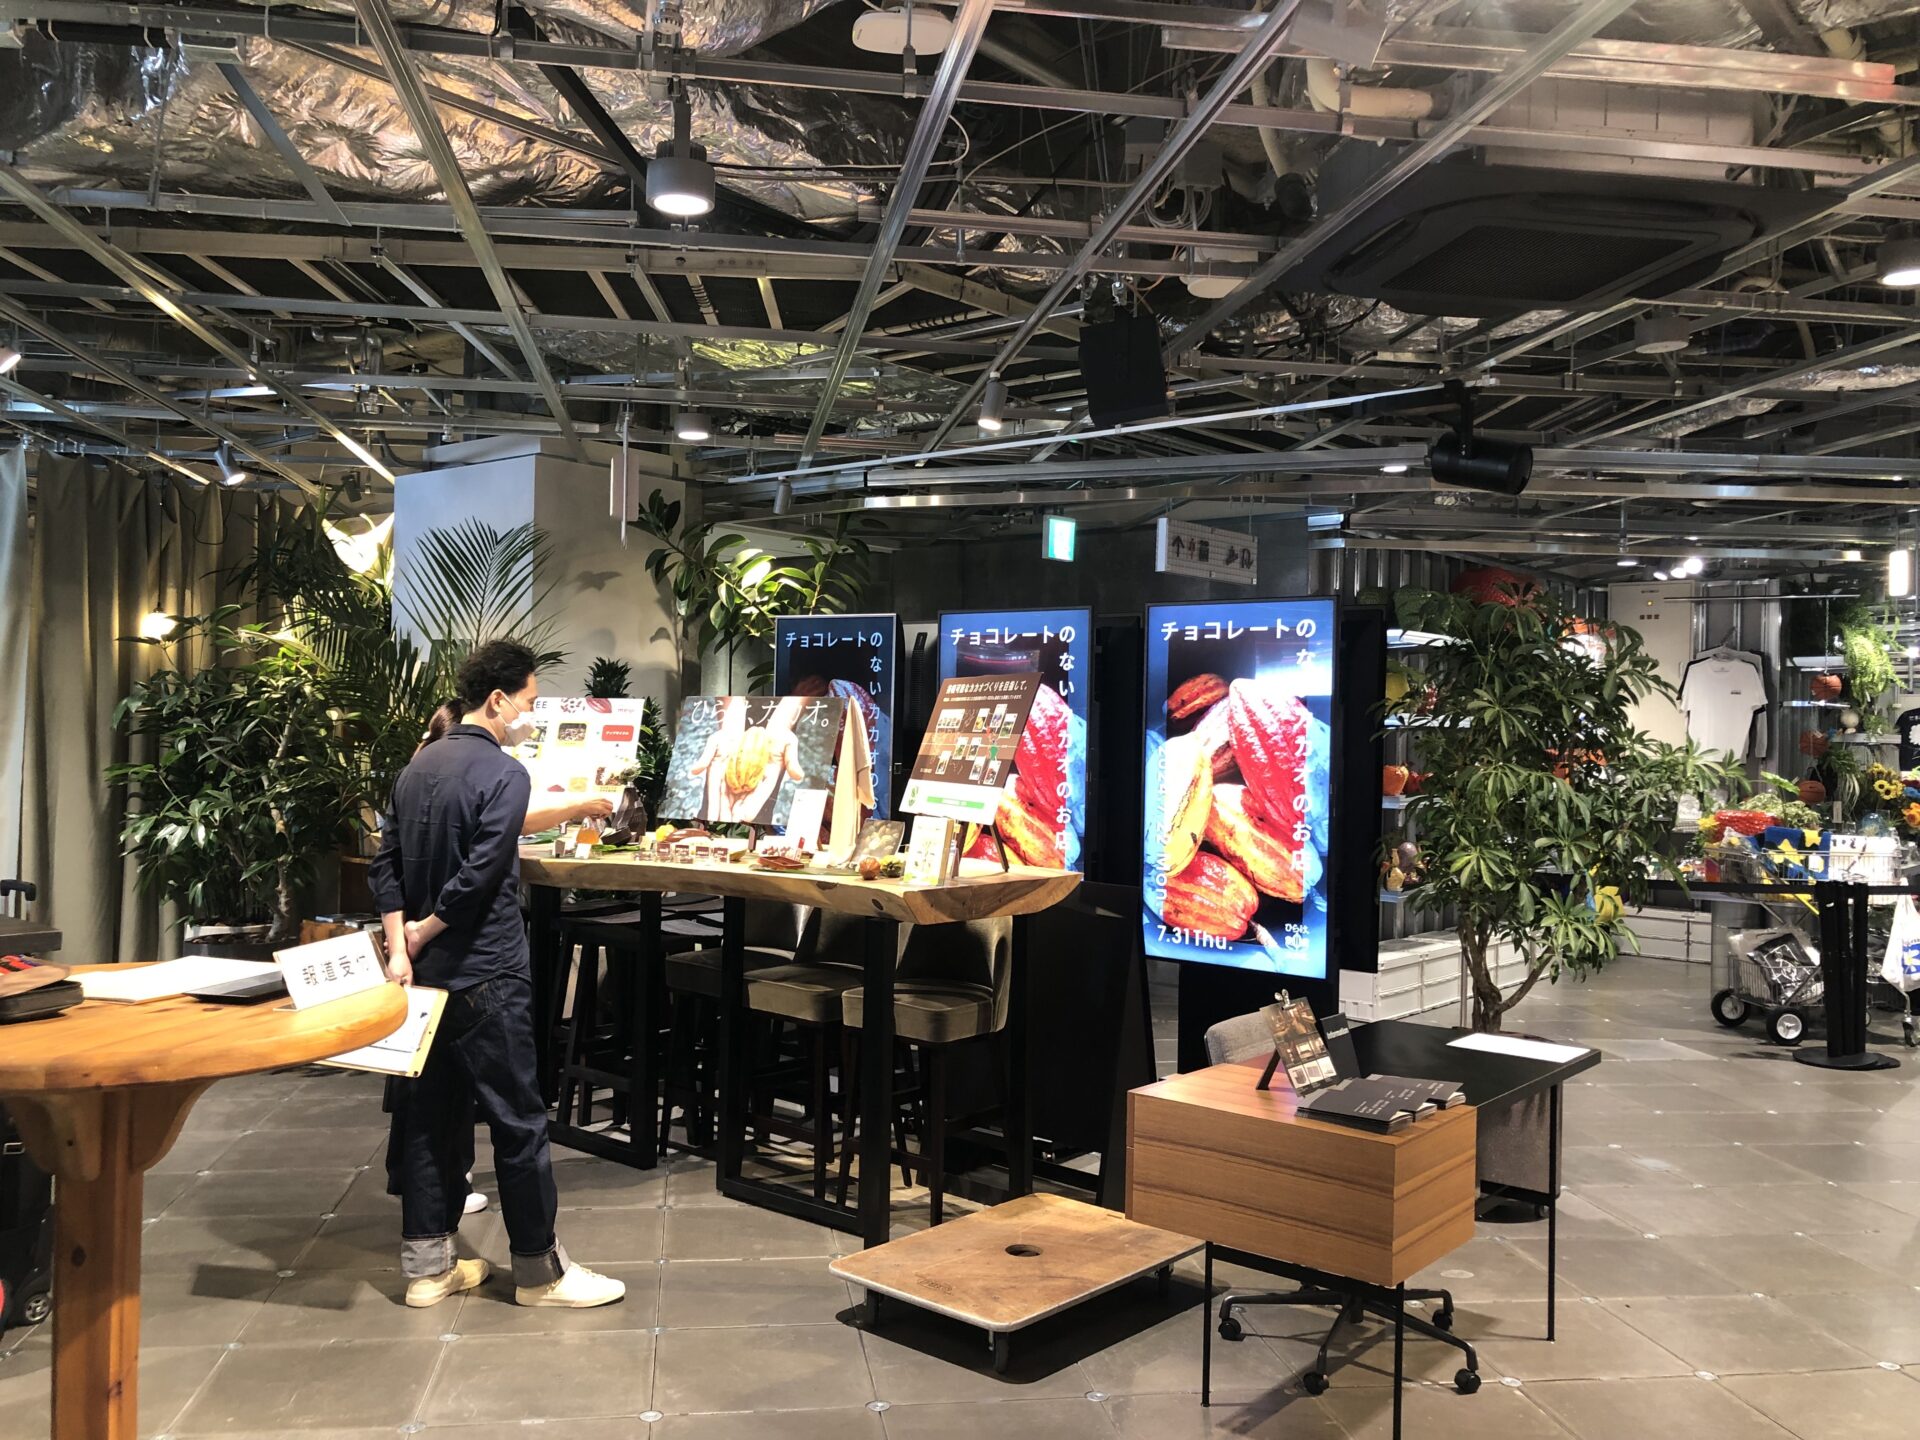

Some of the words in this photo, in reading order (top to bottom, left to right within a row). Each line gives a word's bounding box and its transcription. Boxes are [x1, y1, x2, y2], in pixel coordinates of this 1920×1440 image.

[785, 631, 883, 649] チョコレートの
[950, 624, 1076, 646] チョコレートの
[1160, 617, 1317, 642] チョコレートの
[1055, 652, 1076, 850] ないカカオのお店
[1290, 648, 1317, 872] なカカオのお店
